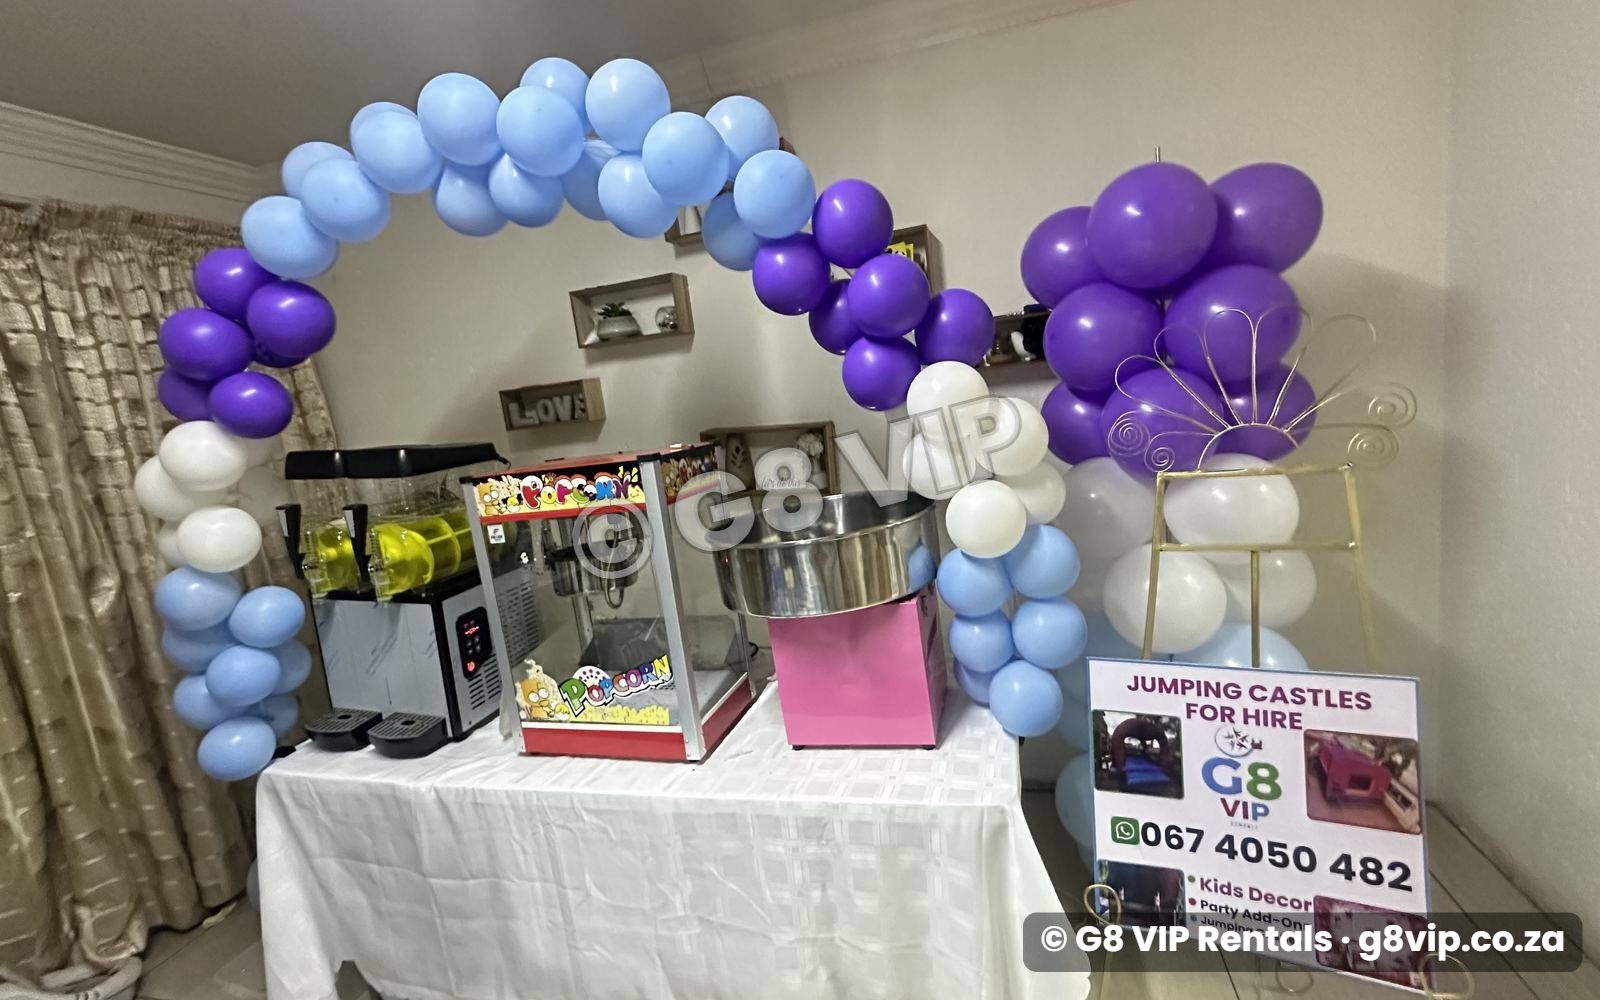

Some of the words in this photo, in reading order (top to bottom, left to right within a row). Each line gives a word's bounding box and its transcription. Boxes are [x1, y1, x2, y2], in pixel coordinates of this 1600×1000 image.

[508, 392, 586, 428] LOVE
[557, 654, 674, 717] POPCORN
[1126, 675, 1243, 701] JUMPING
[1248, 684, 1373, 711] CASTLES
[1185, 702, 1237, 724] FOR
[1242, 707, 1304, 730] HIRE
[1201, 756, 1283, 801] G8
[1220, 797, 1270, 821] VIP
[1140, 821, 1206, 854] 067
[1214, 833, 1318, 874] 4050
[1328, 852, 1414, 893] 482
[1200, 877, 1244, 899] Kids
[1248, 886, 1313, 912] Decor
[1200, 900, 1239, 919] Party
[1242, 909, 1311, 931] Add-On
